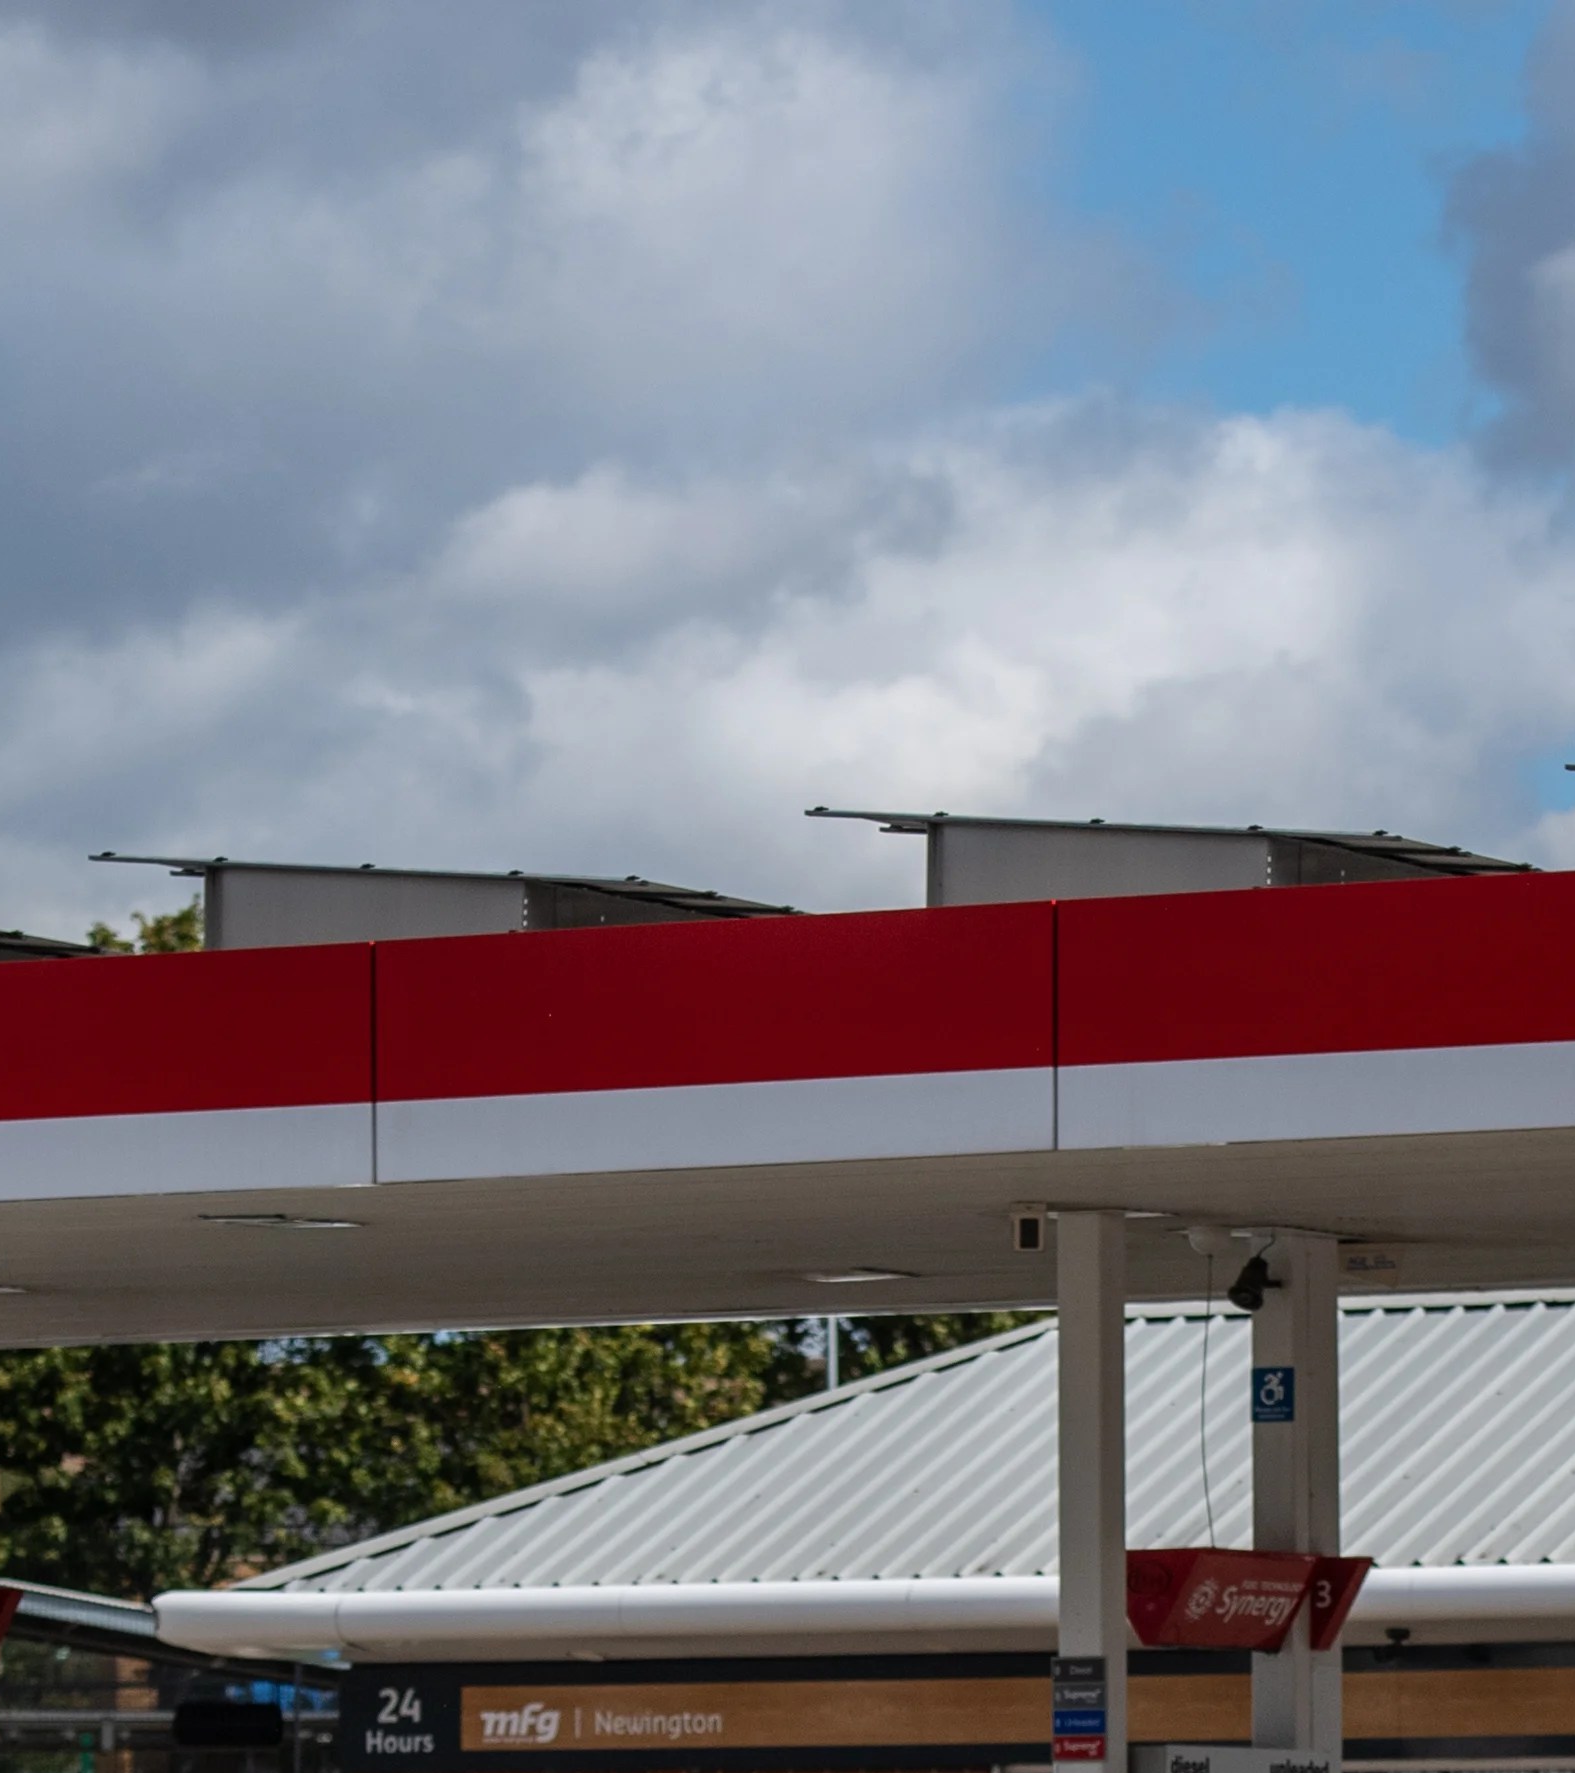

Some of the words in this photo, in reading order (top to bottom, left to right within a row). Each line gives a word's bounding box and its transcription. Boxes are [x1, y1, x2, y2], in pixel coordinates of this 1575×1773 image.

[1215, 1590, 1295, 1625] Synergy
[1317, 1581, 1332, 1608] 3
[377, 1687, 422, 1724] 24
[480, 1702, 560, 1744] mfg
[594, 1710, 723, 1739] Newington
[365, 1729, 435, 1755] Hours
